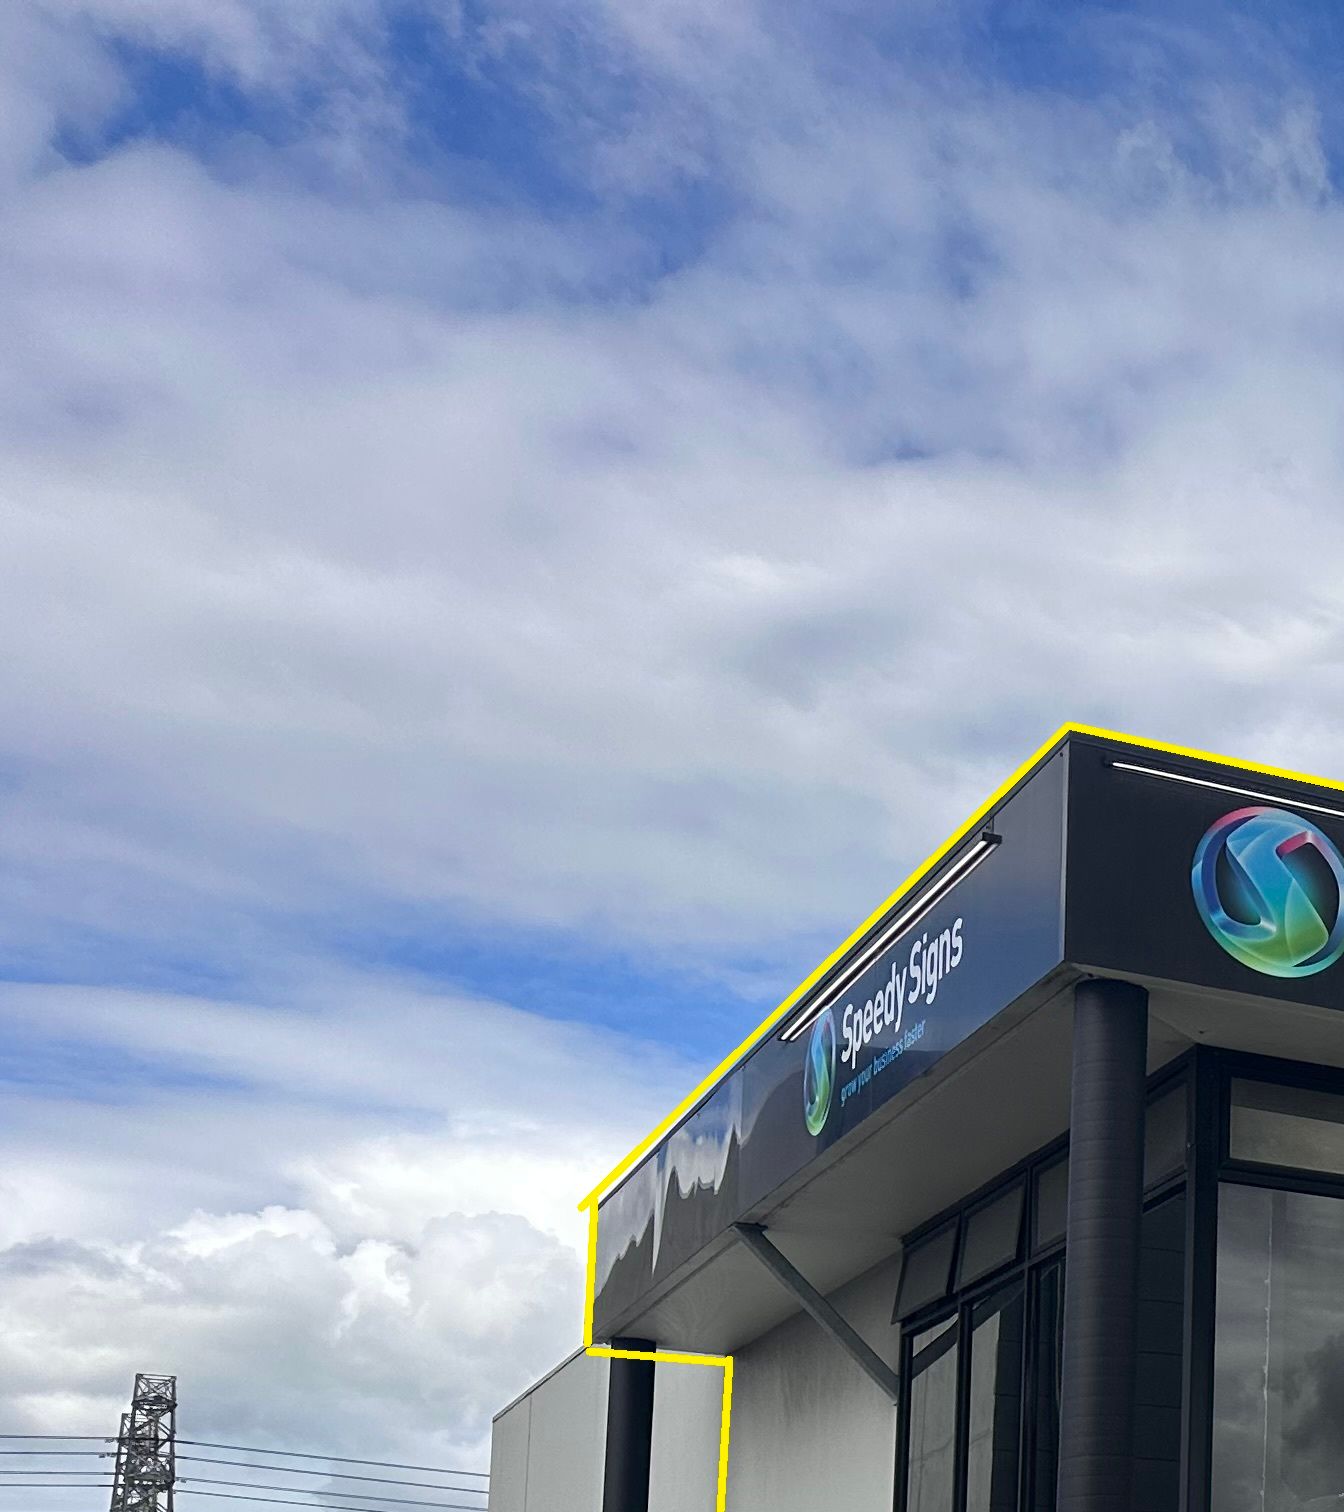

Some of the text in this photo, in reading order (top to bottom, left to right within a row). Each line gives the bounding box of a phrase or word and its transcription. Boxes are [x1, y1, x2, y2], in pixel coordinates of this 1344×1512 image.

[841, 918, 963, 1069] Speedy Signs
[840, 1018, 926, 1107] grow your business faster
